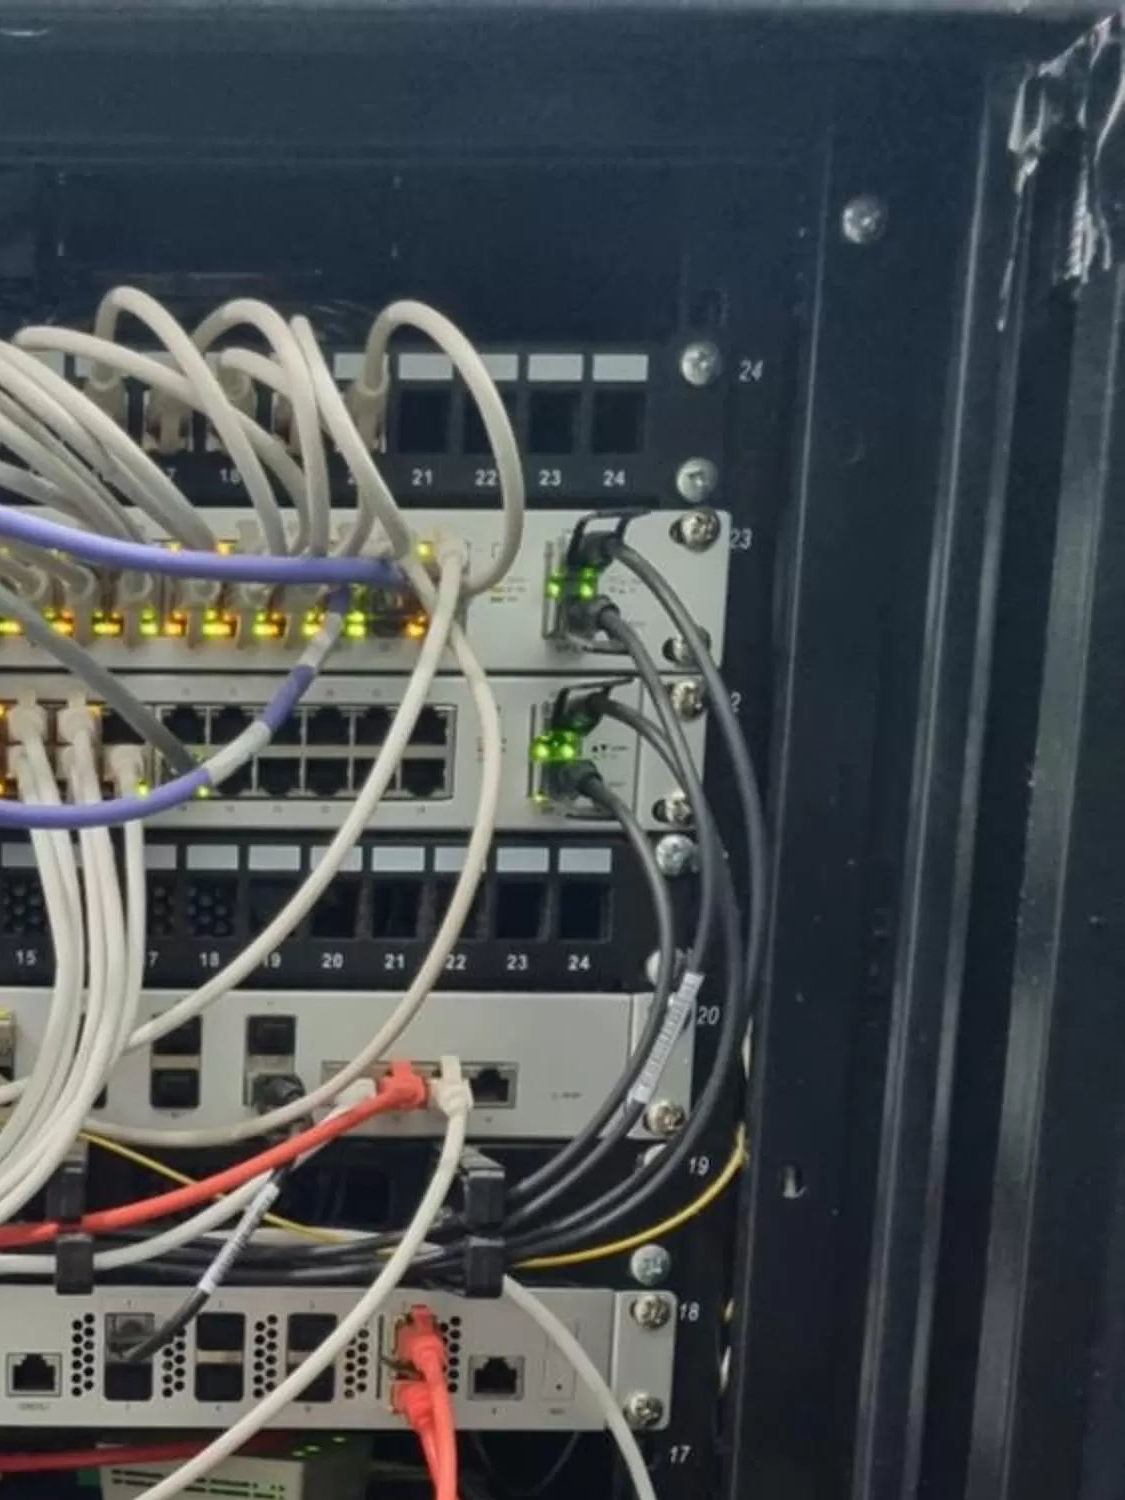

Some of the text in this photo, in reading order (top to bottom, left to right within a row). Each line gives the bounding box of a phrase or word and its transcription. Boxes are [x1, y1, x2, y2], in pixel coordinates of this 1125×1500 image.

[739, 360, 763, 381] 24
[412, 469, 432, 485] 21
[475, 469, 498, 486] 22
[539, 470, 561, 486] 23
[604, 470, 625, 486] 24
[16, 950, 36, 965] 15
[200, 952, 219, 967] 18
[322, 953, 343, 968] 20
[385, 954, 404, 969] 21
[446, 954, 467, 970] 22
[507, 954, 527, 970] 23
[569, 955, 589, 970] 24
[697, 1006, 720, 1025] 20
[690, 1156, 709, 1175] 19
[678, 1302, 700, 1321] 18
[671, 1445, 690, 1462] 17
